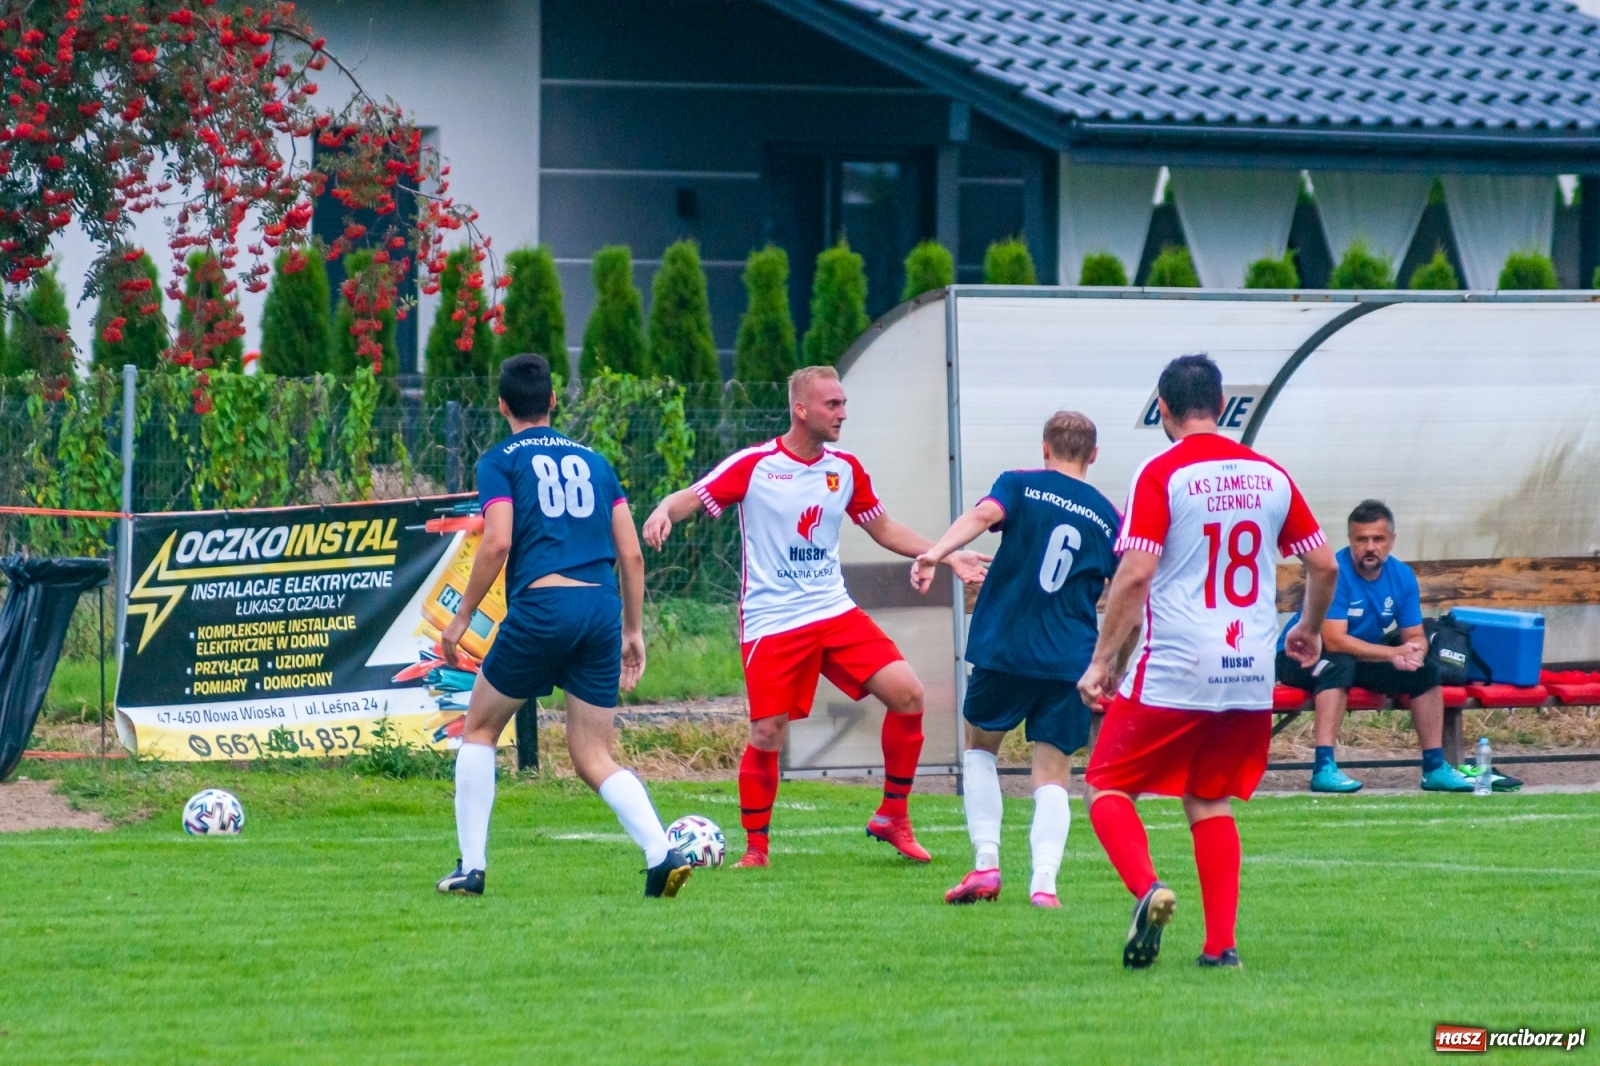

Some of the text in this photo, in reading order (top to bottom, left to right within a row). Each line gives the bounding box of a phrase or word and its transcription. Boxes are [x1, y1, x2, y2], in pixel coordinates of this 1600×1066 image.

[531, 454, 595, 518] 88
[1024, 486, 1041, 500] LKS
[1188, 474, 1274, 496] LKS ZAMECZEK
[1207, 493, 1262, 512] CZERNICA
[175, 518, 398, 564] OCZKOINSTAL
[789, 545, 827, 561] Husar
[1039, 523, 1082, 594] 6
[1203, 520, 1262, 609] 18
[191, 570, 393, 600] INSTALACJE ELEKTRYCZNE
[235, 594, 346, 616] ŁUKASZ OCZADŁY
[197, 615, 357, 640] KOMPLEKSOWE INSTALACJE
[196, 633, 330, 656] ELEKTRYCZNE W DOMU
[194, 653, 325, 677] PRZYŁĄCZA UZIOMY
[1221, 655, 1255, 669] Husar
[193, 672, 334, 696] POMIARY DOMOFONY
[1208, 676, 1240, 684] GALERIA
[157, 704, 286, 724] 47-450 Nowa Wioska
[305, 697, 379, 716] ul. Leśna 24
[215, 733, 263, 757] 661
[315, 725, 363, 751] 852
